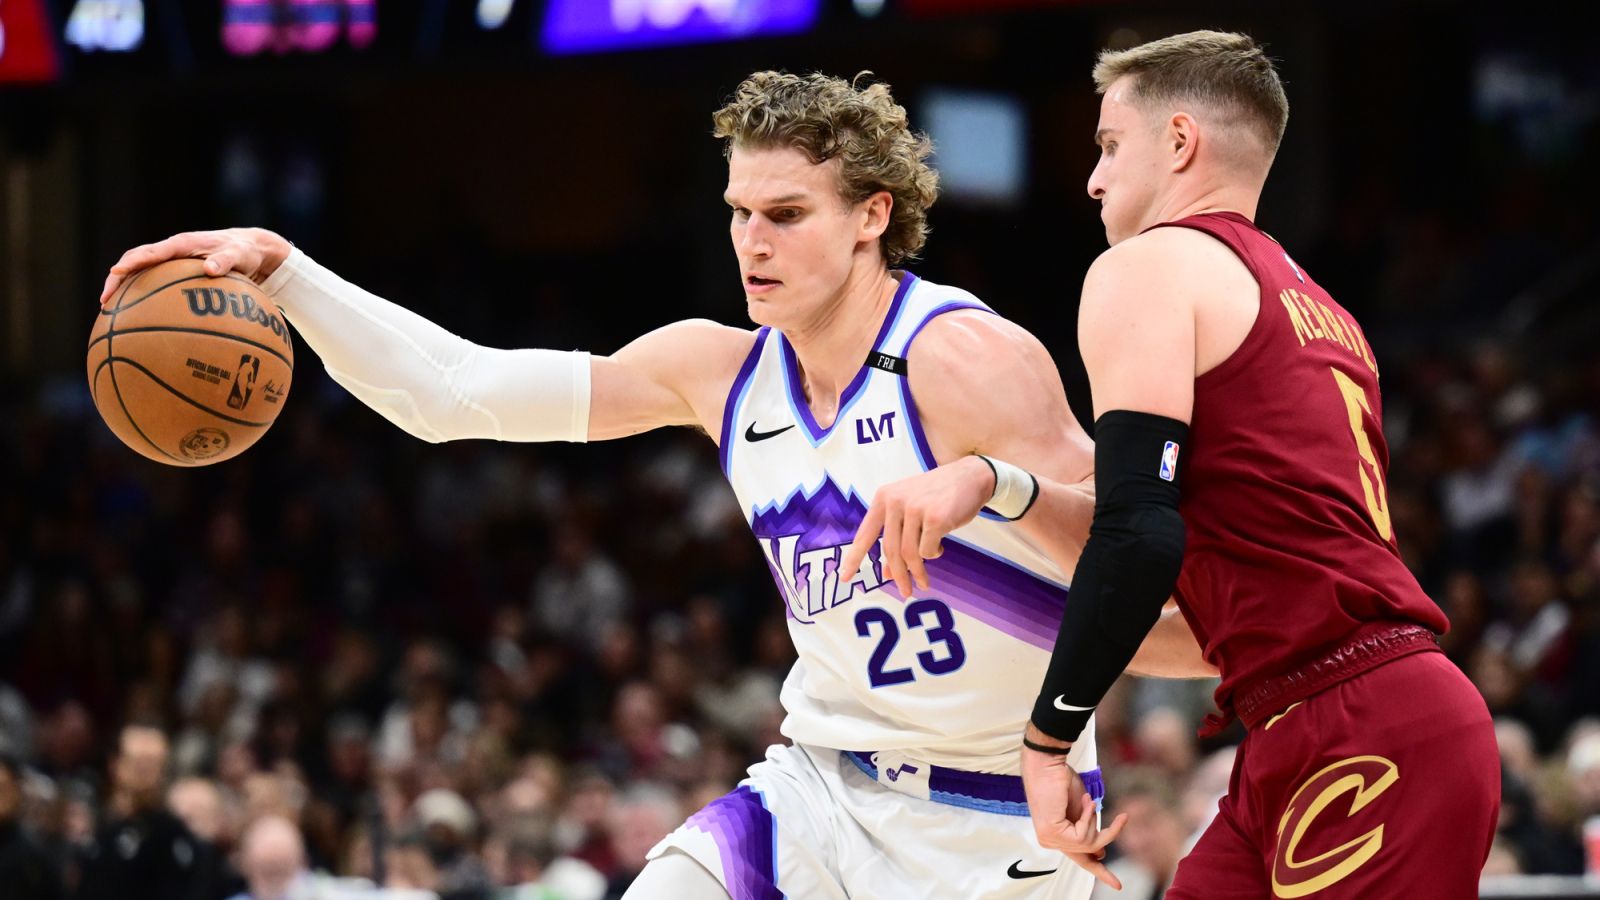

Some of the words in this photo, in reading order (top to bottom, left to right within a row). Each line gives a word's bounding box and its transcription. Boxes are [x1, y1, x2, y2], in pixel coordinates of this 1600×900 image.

[181, 287, 291, 352] Wilson
[1279, 287, 1379, 378] MERRIL
[856, 411, 895, 445] LVT
[1330, 366, 1391, 541] 5
[757, 534, 895, 624] UTA
[854, 597, 967, 689] 23
[1271, 755, 1400, 899] C
